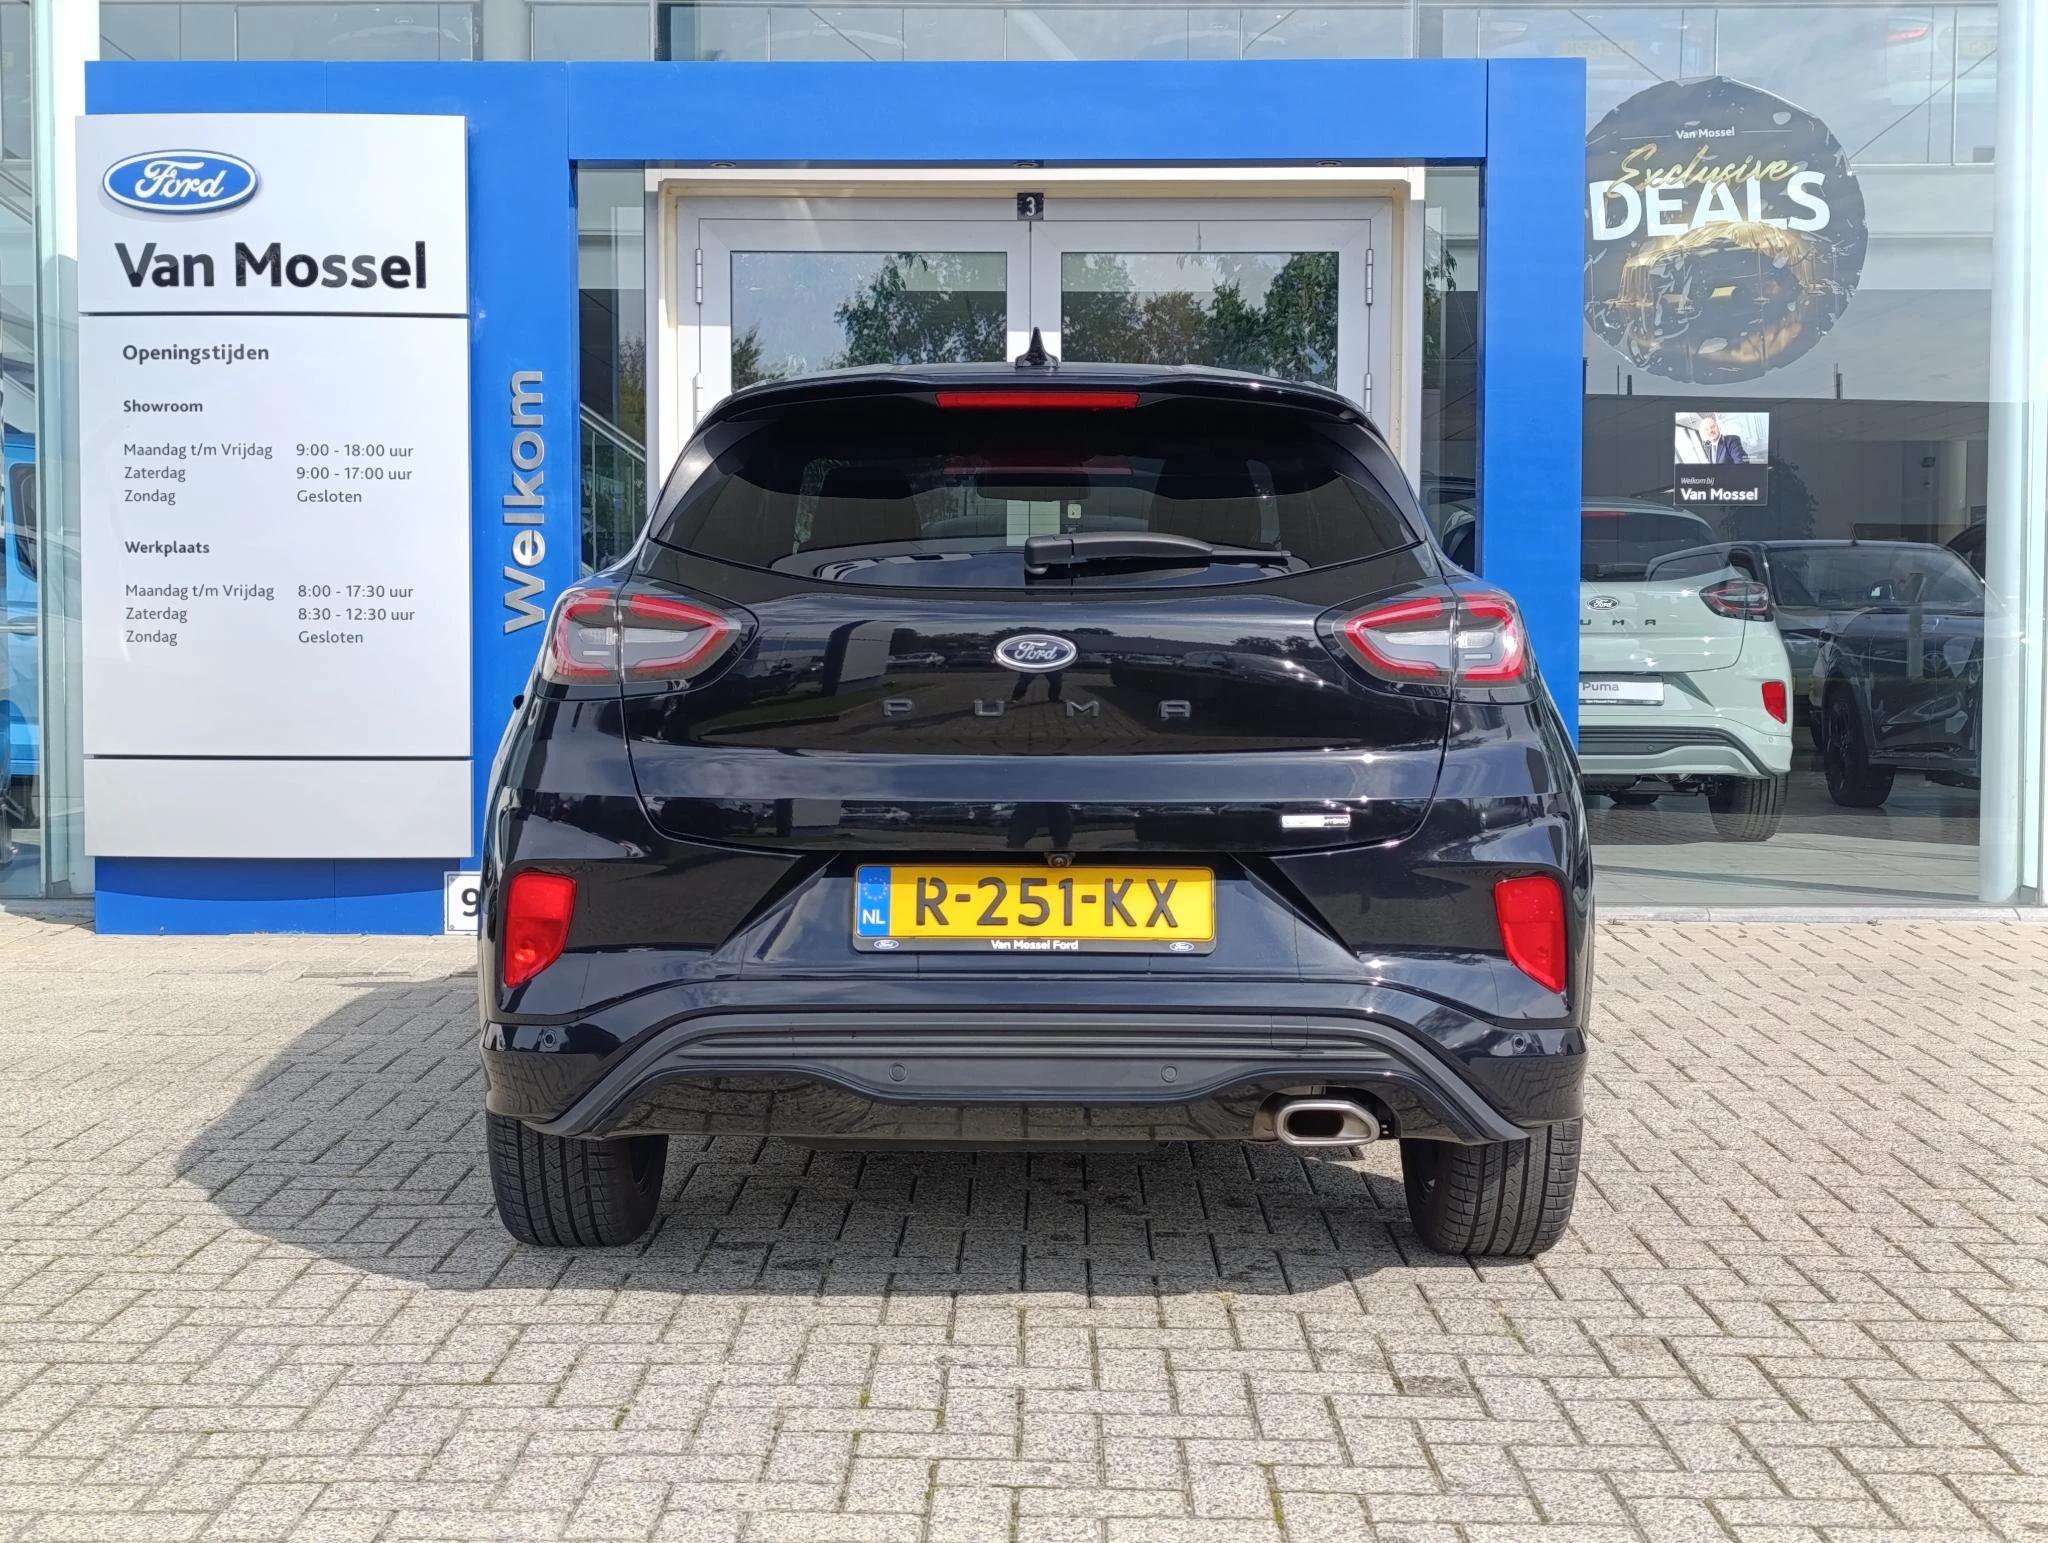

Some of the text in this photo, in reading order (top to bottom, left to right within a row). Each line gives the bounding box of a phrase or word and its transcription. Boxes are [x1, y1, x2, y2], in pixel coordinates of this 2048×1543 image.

[1676, 126, 1735, 140] Van Mossel
[134, 159, 225, 199] Ford
[1607, 143, 1797, 198] Exclusive
[1025, 196, 1036, 217] 3
[1588, 170, 1831, 241] DEALS
[114, 240, 427, 290] Van Mossel
[122, 343, 270, 366] Openingstijden
[123, 399, 204, 413] Showroom
[123, 442, 188, 460] Maandag
[190, 442, 217, 457] t/m
[221, 442, 273, 460] Vrijdag
[296, 443, 330, 457] 9:00
[343, 443, 385, 457] 18:00
[389, 447, 414, 458] uur
[123, 465, 187, 483] Zaterdag
[296, 466, 330, 480] 9:00
[343, 466, 384, 480] 17:00
[388, 470, 413, 481] uur
[123, 488, 362, 506] Zondag Gesloten
[503, 369, 546, 635] Welkom
[1680, 487, 1759, 501] Van Mossel
[124, 539, 210, 558] Werkplaats
[125, 583, 189, 601] Maandag
[191, 583, 219, 598] t/m
[222, 583, 275, 602] Vrijdag
[297, 584, 332, 598] 8:00
[345, 584, 385, 598] 17:30
[389, 588, 414, 599] uur
[125, 606, 188, 624] Zaterdag
[298, 607, 331, 621] 8:30
[345, 607, 387, 621] 12:30
[390, 611, 416, 622] uur
[125, 629, 364, 647] Zondag Gesloten
[1582, 681, 1620, 692] Puma
[882, 699, 1192, 720] PUMA
[461, 887, 480, 918] 9
[915, 876, 1179, 929] R-251-KX
[863, 909, 887, 925] NL
[991, 939, 1079, 950] Van Mossel Ford
